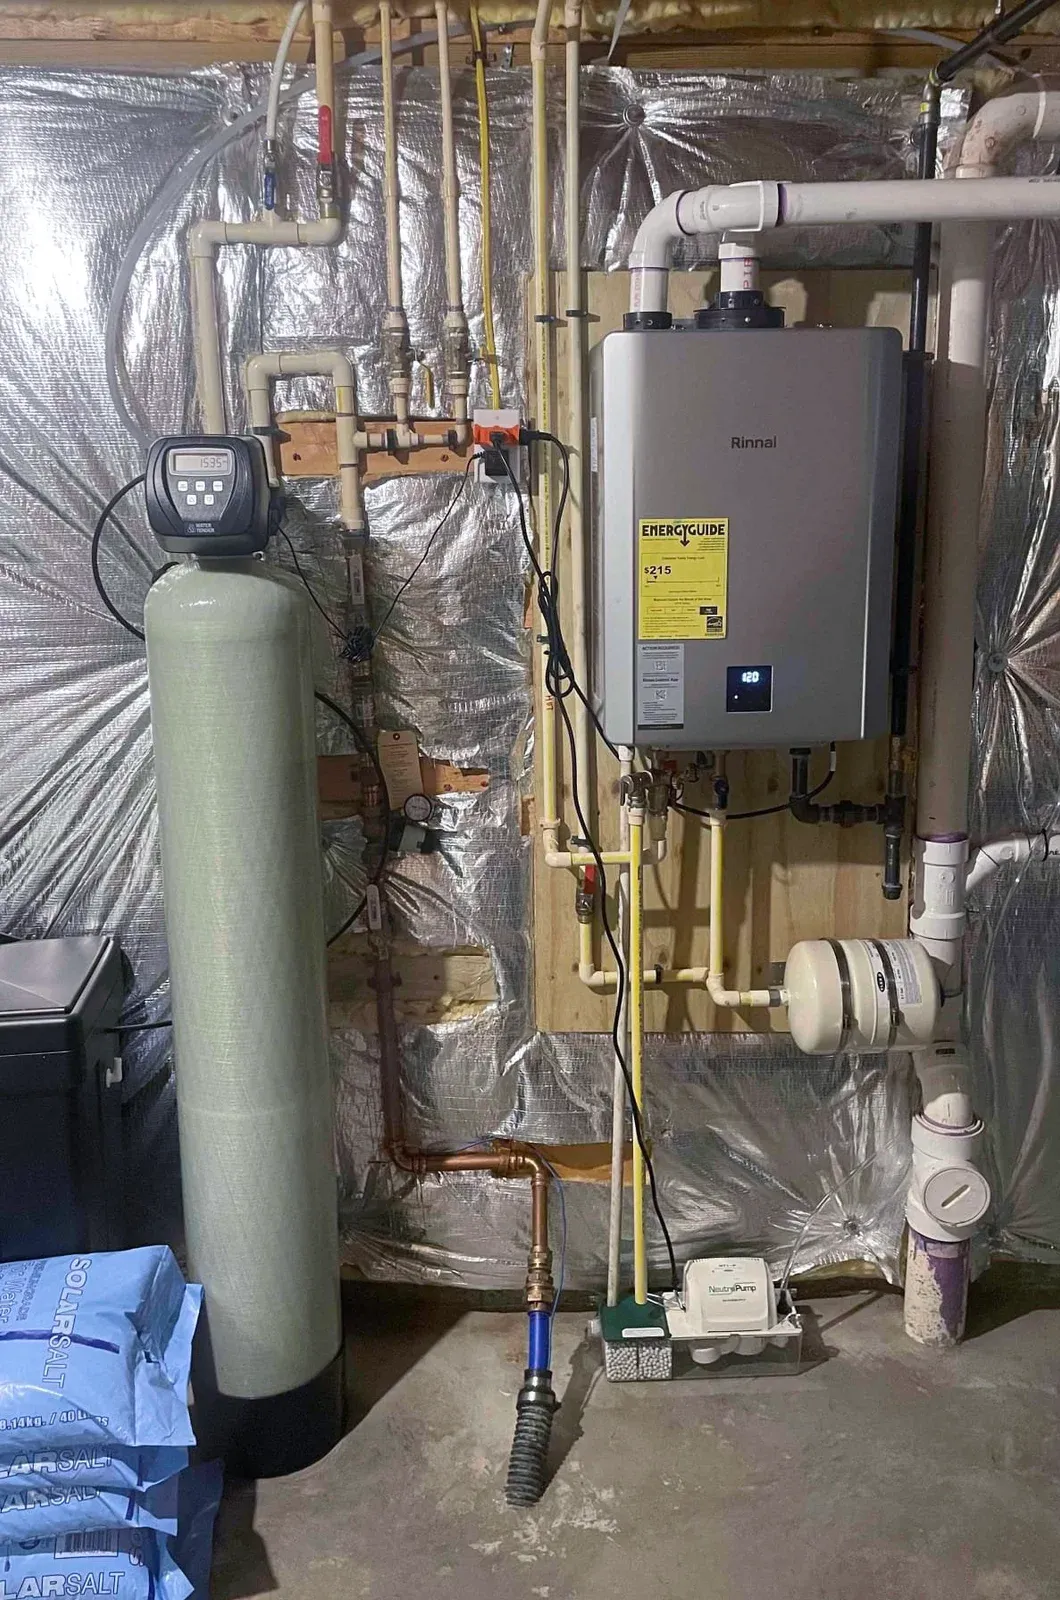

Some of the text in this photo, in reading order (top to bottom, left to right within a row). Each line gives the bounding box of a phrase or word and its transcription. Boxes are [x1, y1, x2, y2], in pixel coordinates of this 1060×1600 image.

[642, 524, 725, 537] ENERGYGUIDE
[644, 566, 672, 575] $215
[742, 671, 760, 683] 120
[41, 1258, 92, 1388] SOLARSALT
[59, 1410, 76, 1423] 40
